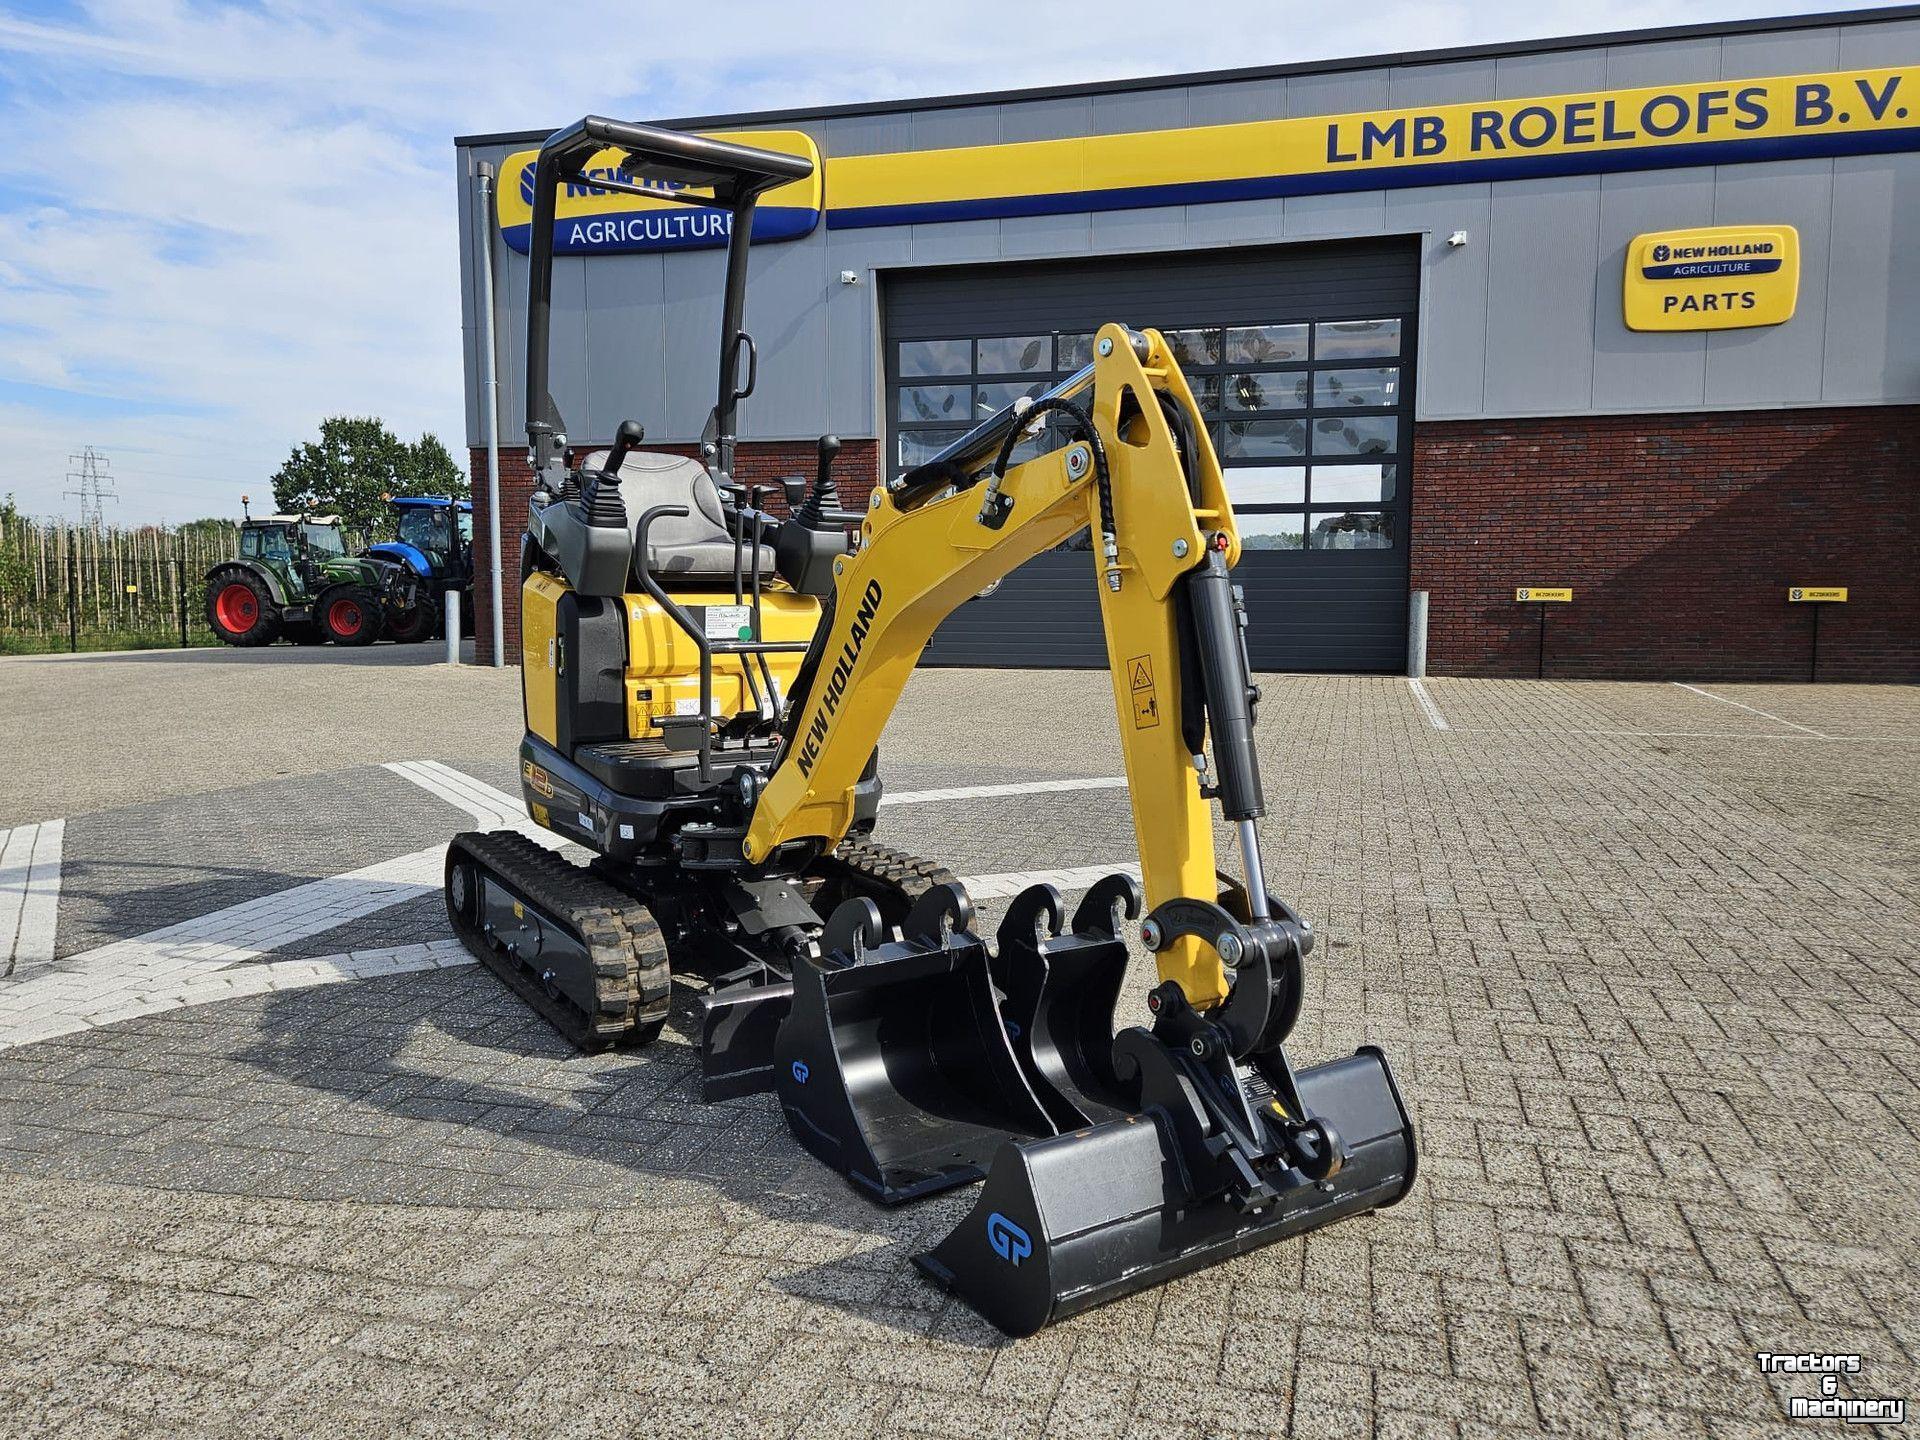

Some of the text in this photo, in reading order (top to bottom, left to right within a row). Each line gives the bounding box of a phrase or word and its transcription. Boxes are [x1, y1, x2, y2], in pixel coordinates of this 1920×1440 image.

[1326, 76, 1908, 163] LMB ROELOFS B.V.
[1673, 243, 1774, 259] NEW HOLLAND
[1673, 262, 1751, 276] AGRICULTURE
[1663, 291, 1756, 313] PARTS
[796, 578, 883, 780] NEW HOLLAND
